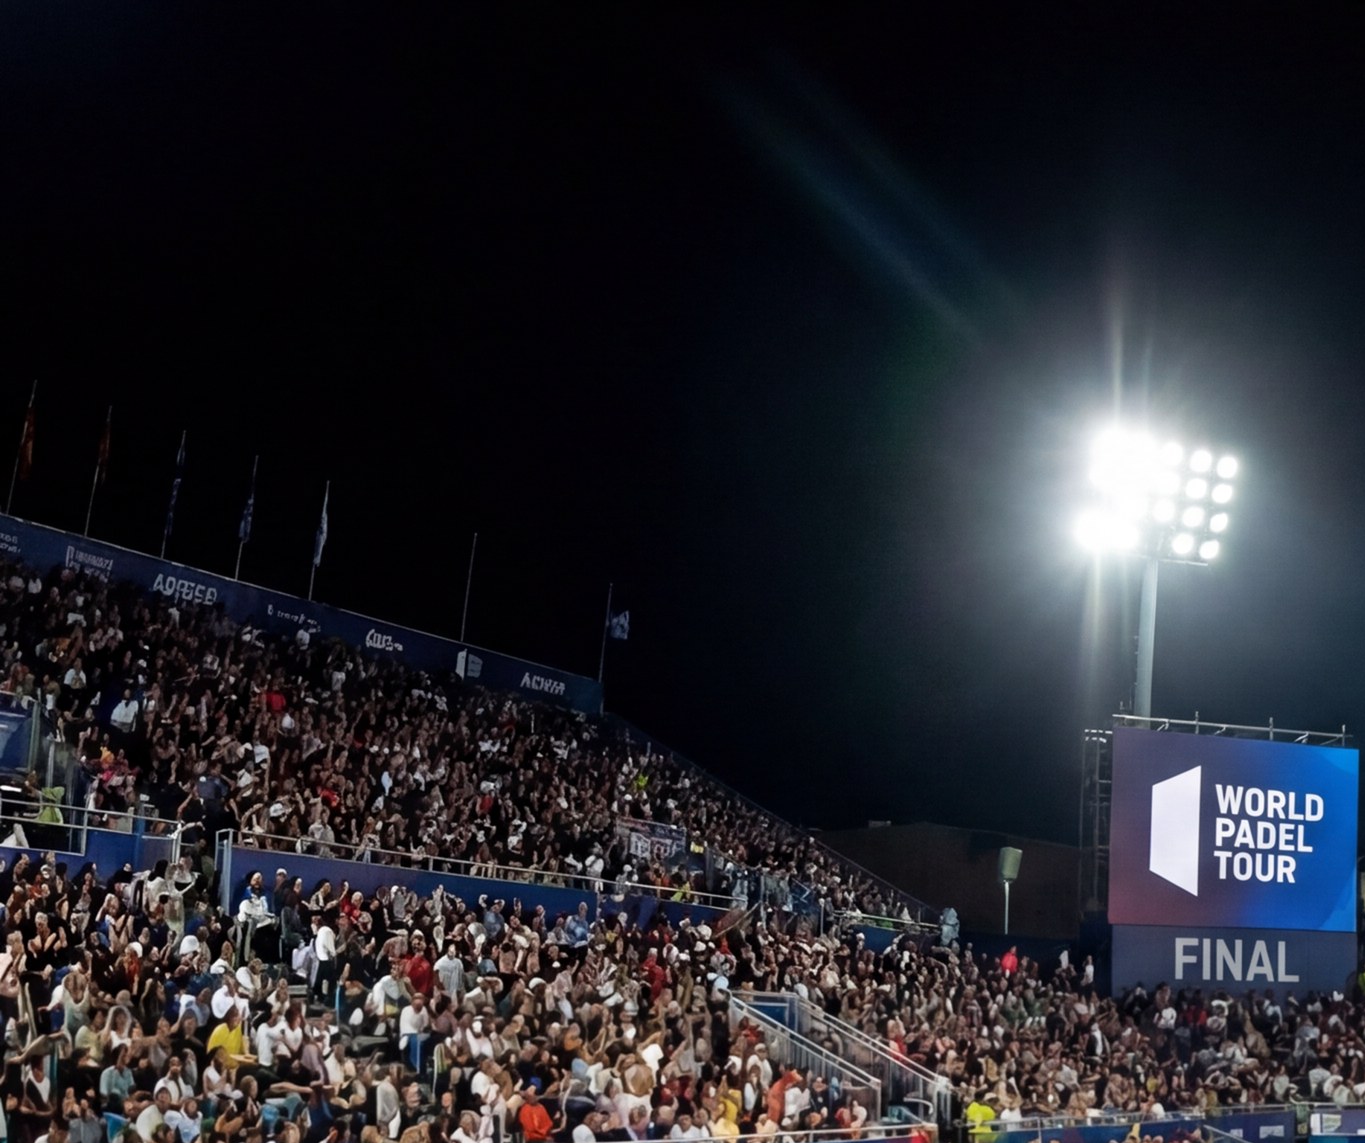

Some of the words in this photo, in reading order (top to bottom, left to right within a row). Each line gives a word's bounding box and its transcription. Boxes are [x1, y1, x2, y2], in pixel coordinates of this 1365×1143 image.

[1215, 783, 1324, 822] WORLD
[1215, 817, 1313, 853] PADEL
[1213, 850, 1297, 884] TOUR
[1174, 937, 1300, 983] FINAL
